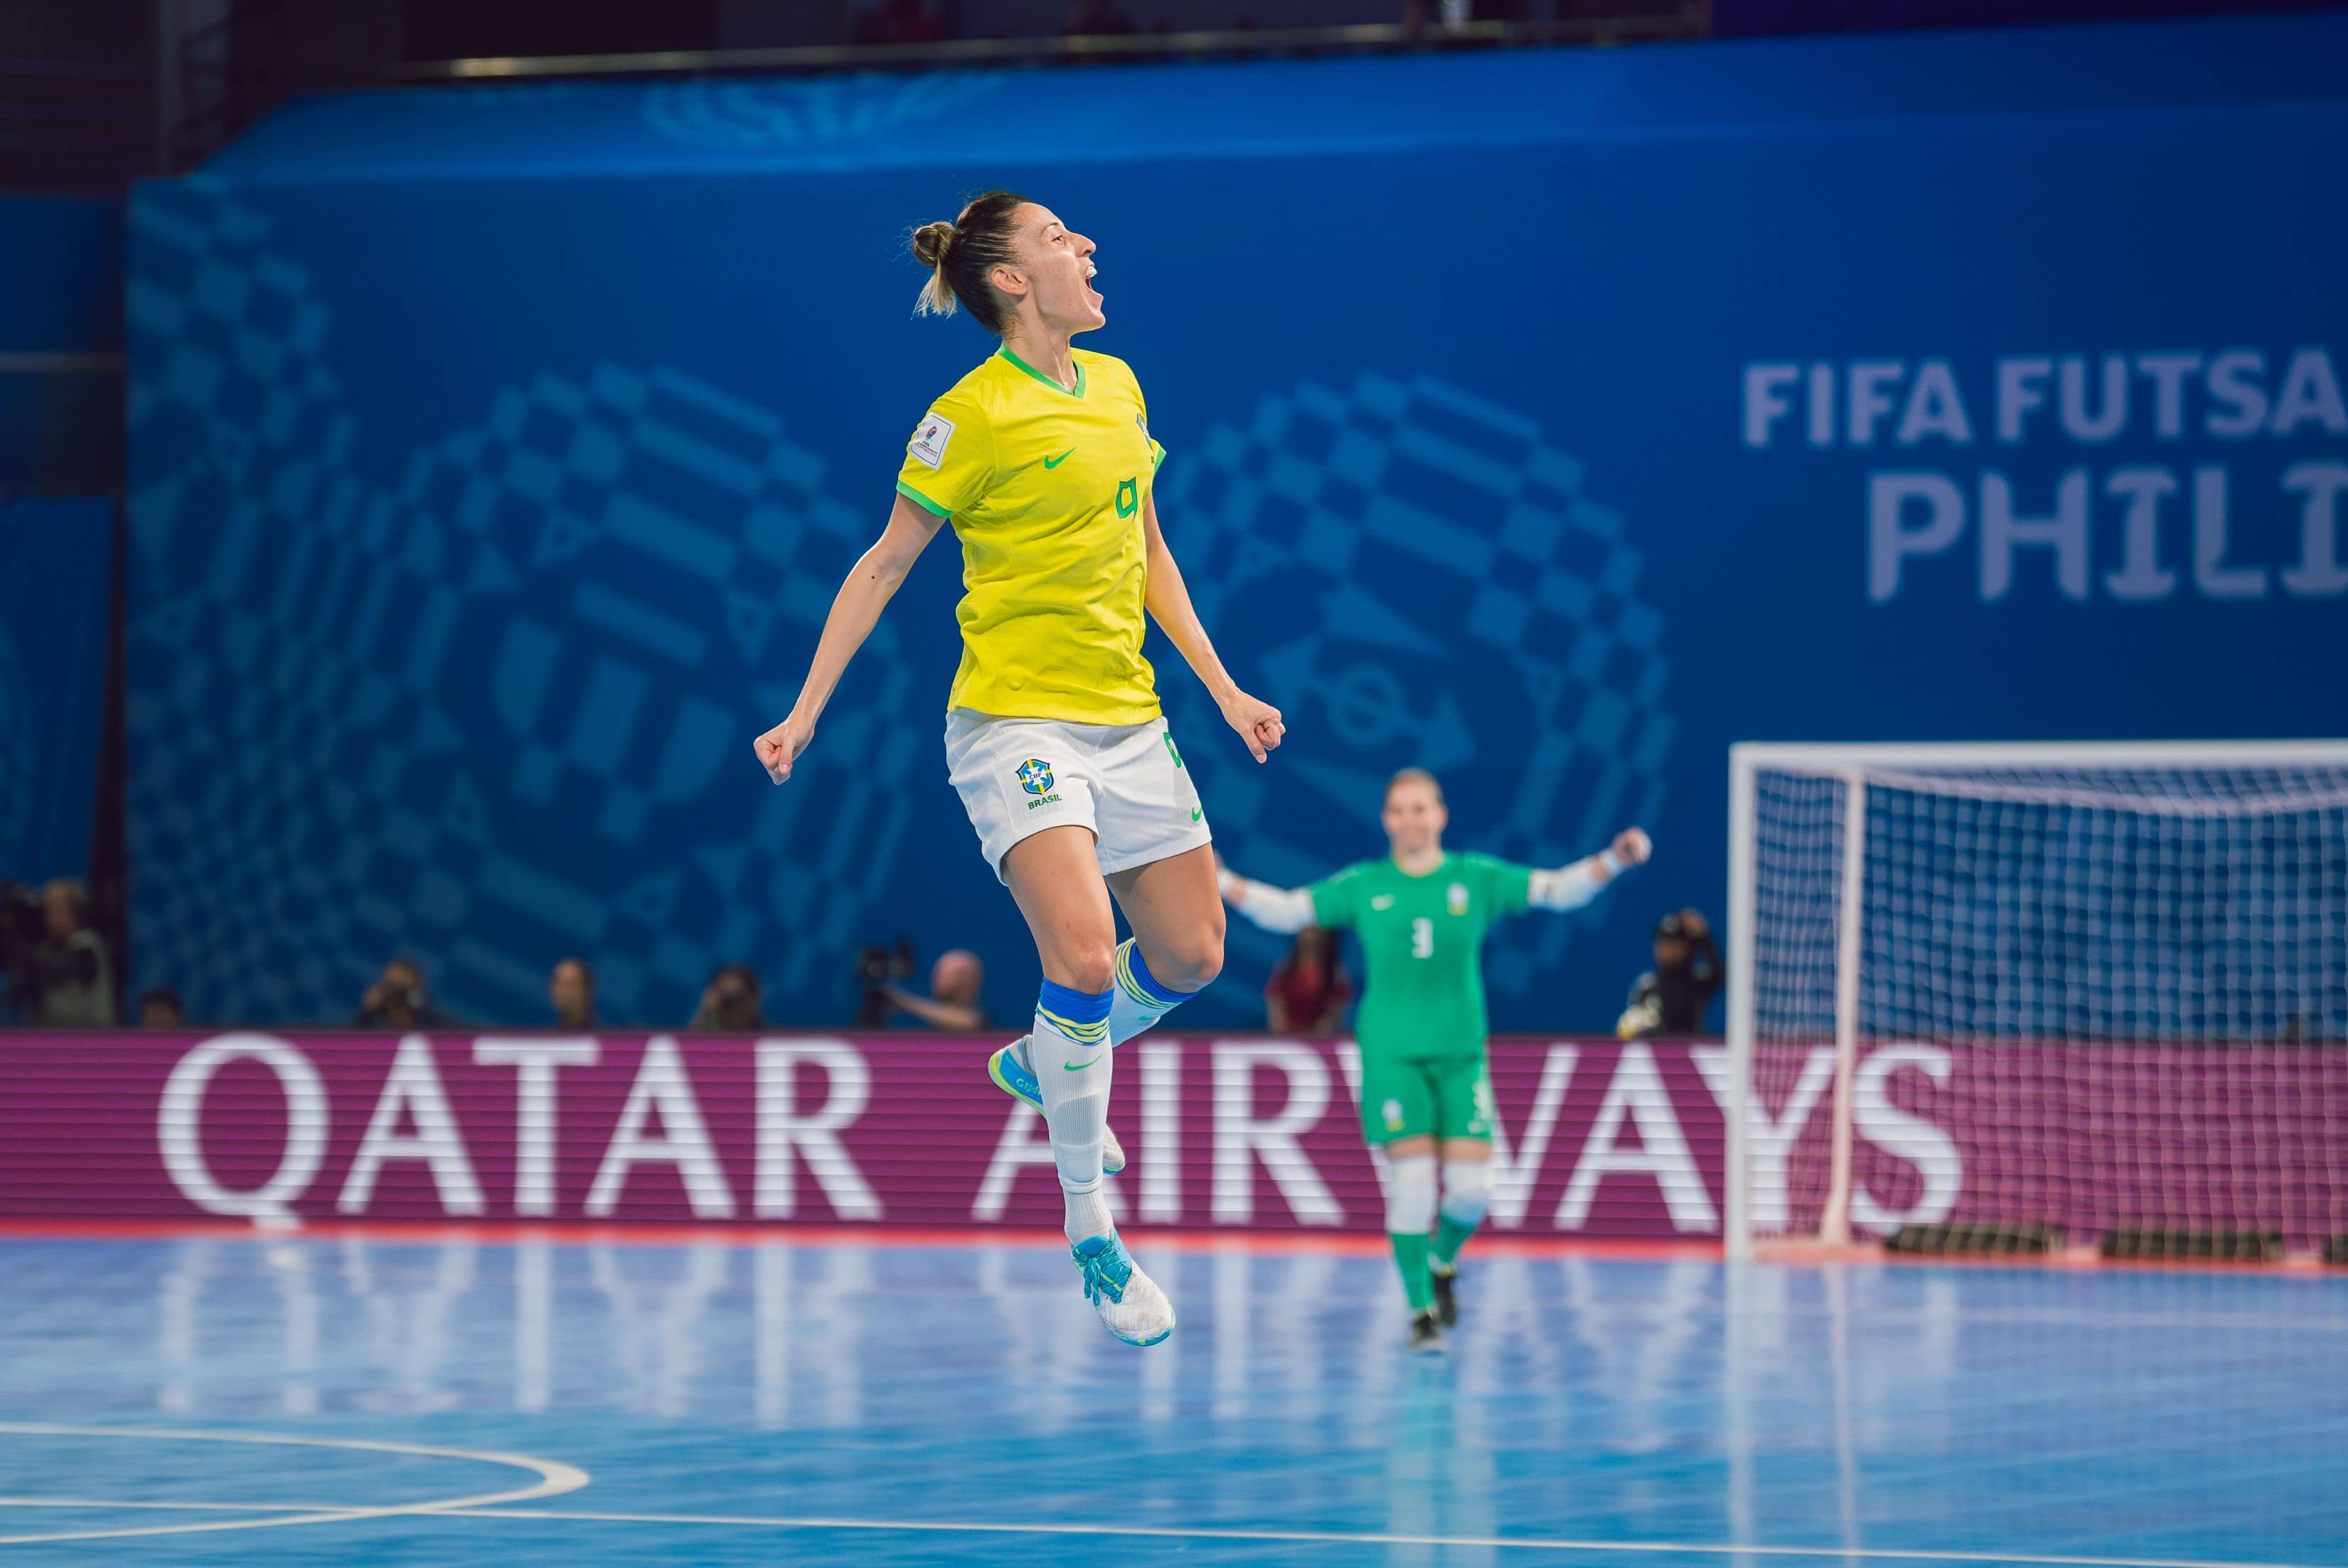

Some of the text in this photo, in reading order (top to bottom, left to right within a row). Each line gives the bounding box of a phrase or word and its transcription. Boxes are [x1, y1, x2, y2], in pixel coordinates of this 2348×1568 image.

[1744, 350, 2348, 447] FIFA FUTSA
[1115, 476, 1138, 523] 9
[1867, 463, 2348, 603] PHILI
[1028, 794, 1062, 810] BRASIL
[1412, 917, 1434, 959] 3
[158, 1033, 884, 1232] QATAR
